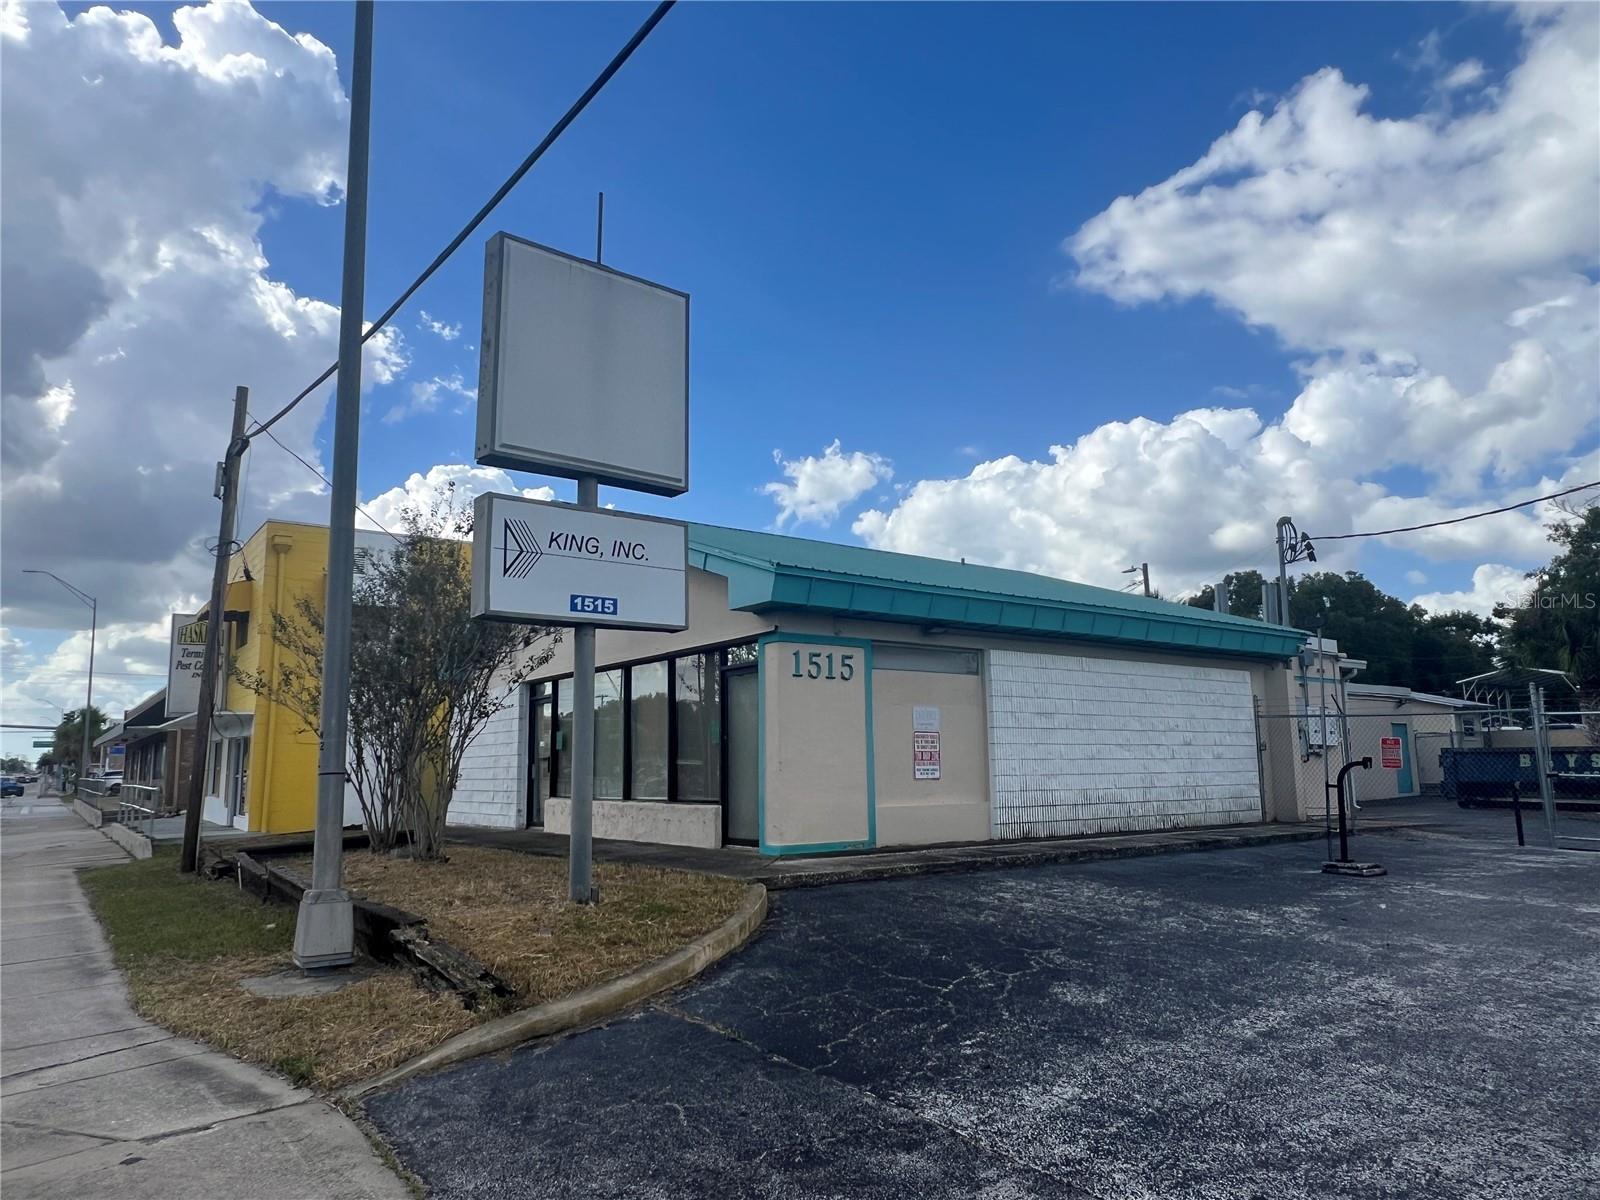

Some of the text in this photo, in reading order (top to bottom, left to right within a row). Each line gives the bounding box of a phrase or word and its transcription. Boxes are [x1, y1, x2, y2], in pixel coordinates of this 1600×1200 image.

[548, 531, 649, 561] KING, INC.
[574, 596, 614, 613] 1515
[175, 660, 192, 670] Pest
[792, 649, 854, 681] 1515
